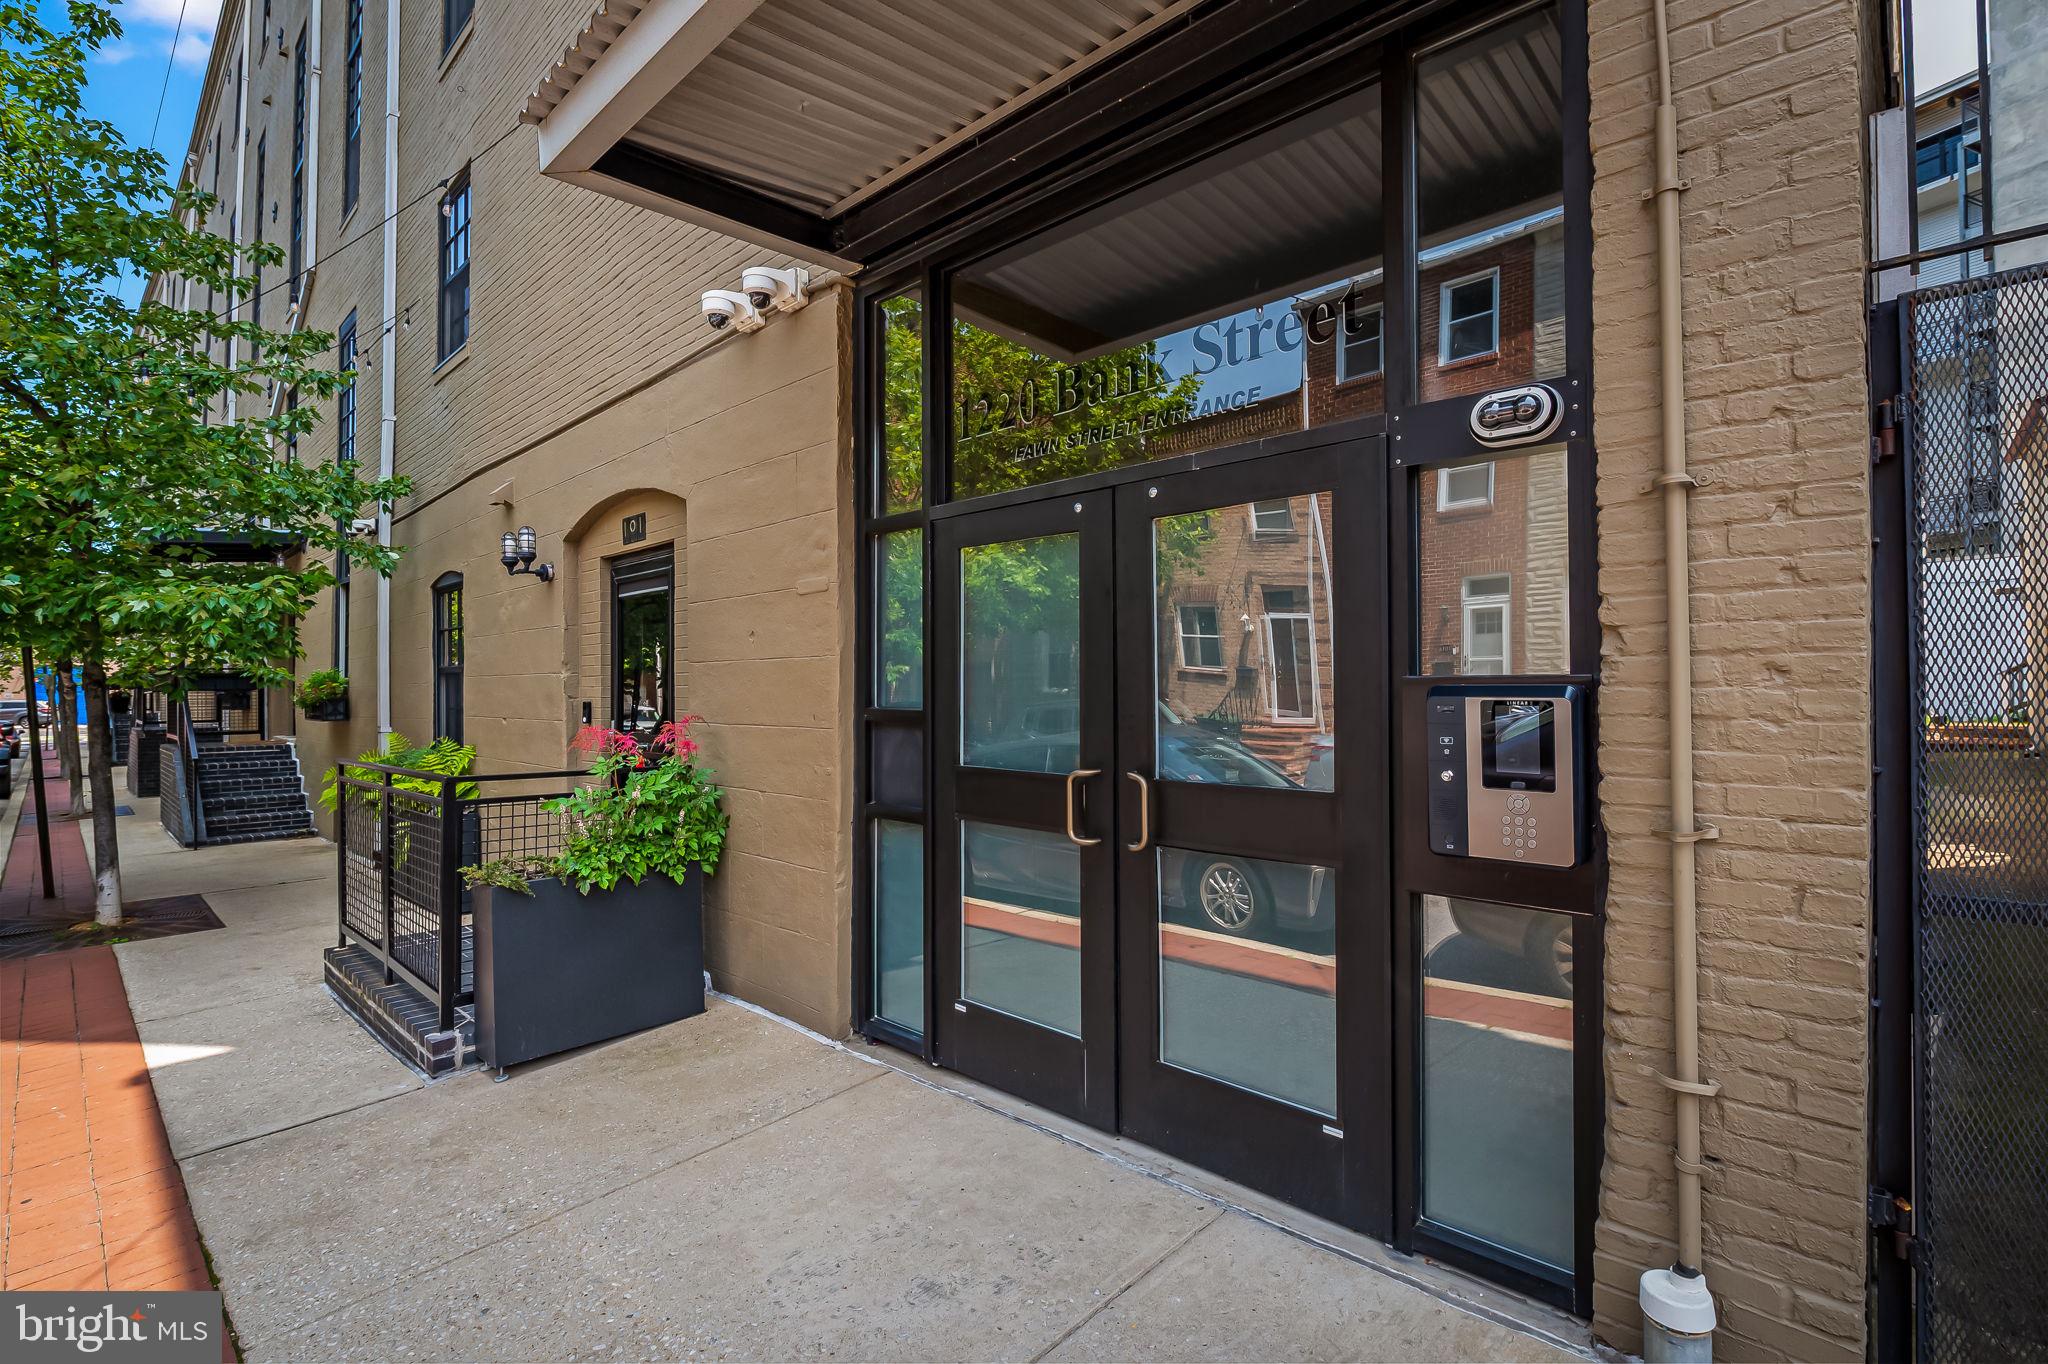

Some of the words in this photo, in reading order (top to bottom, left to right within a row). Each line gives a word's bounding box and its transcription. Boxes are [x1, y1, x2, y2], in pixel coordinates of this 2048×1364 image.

[957, 377, 1040, 442] 1220
[1052, 343, 1178, 417] Bank
[1191, 280, 1364, 376] Street
[1013, 436, 1061, 463] FAWN
[1065, 417, 1136, 450] STREET
[1139, 385, 1262, 434] ENTRANCE
